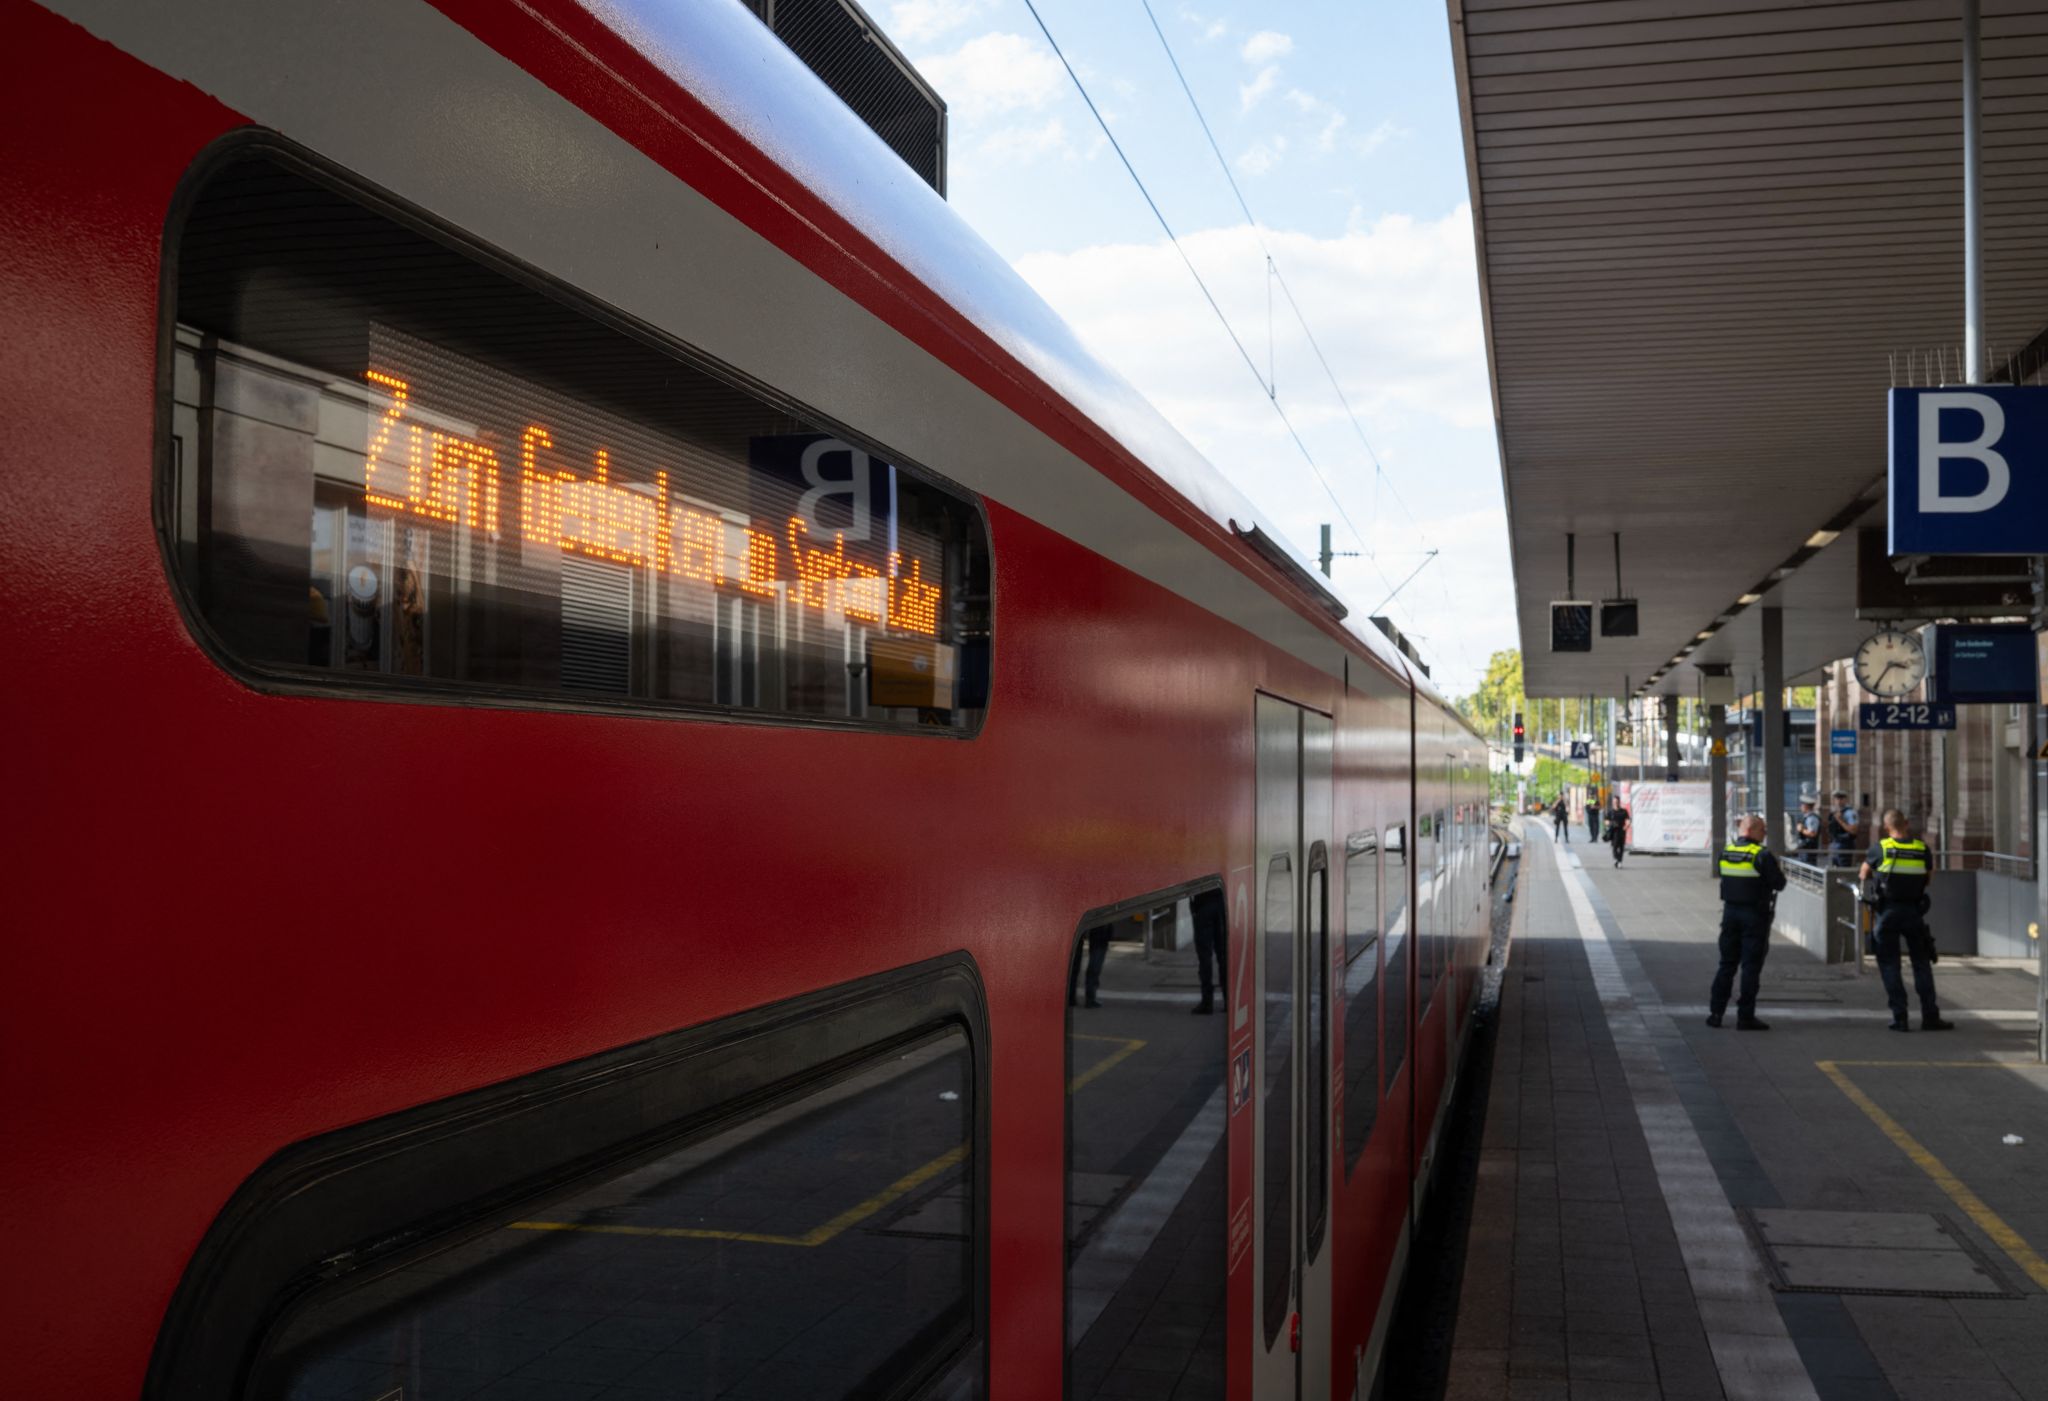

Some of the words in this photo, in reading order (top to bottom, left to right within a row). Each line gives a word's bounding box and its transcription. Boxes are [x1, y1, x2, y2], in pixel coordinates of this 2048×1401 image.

[366, 370, 498, 532] Zum
[522, 426, 724, 585] Gedenken
[740, 528, 776, 597] an
[788, 516, 880, 622] Serkan
[1918, 392, 2010, 513] B
[1574, 742, 1587, 756] A
[1886, 705, 1930, 724] 2-12
[1234, 882, 1248, 1031] 2
